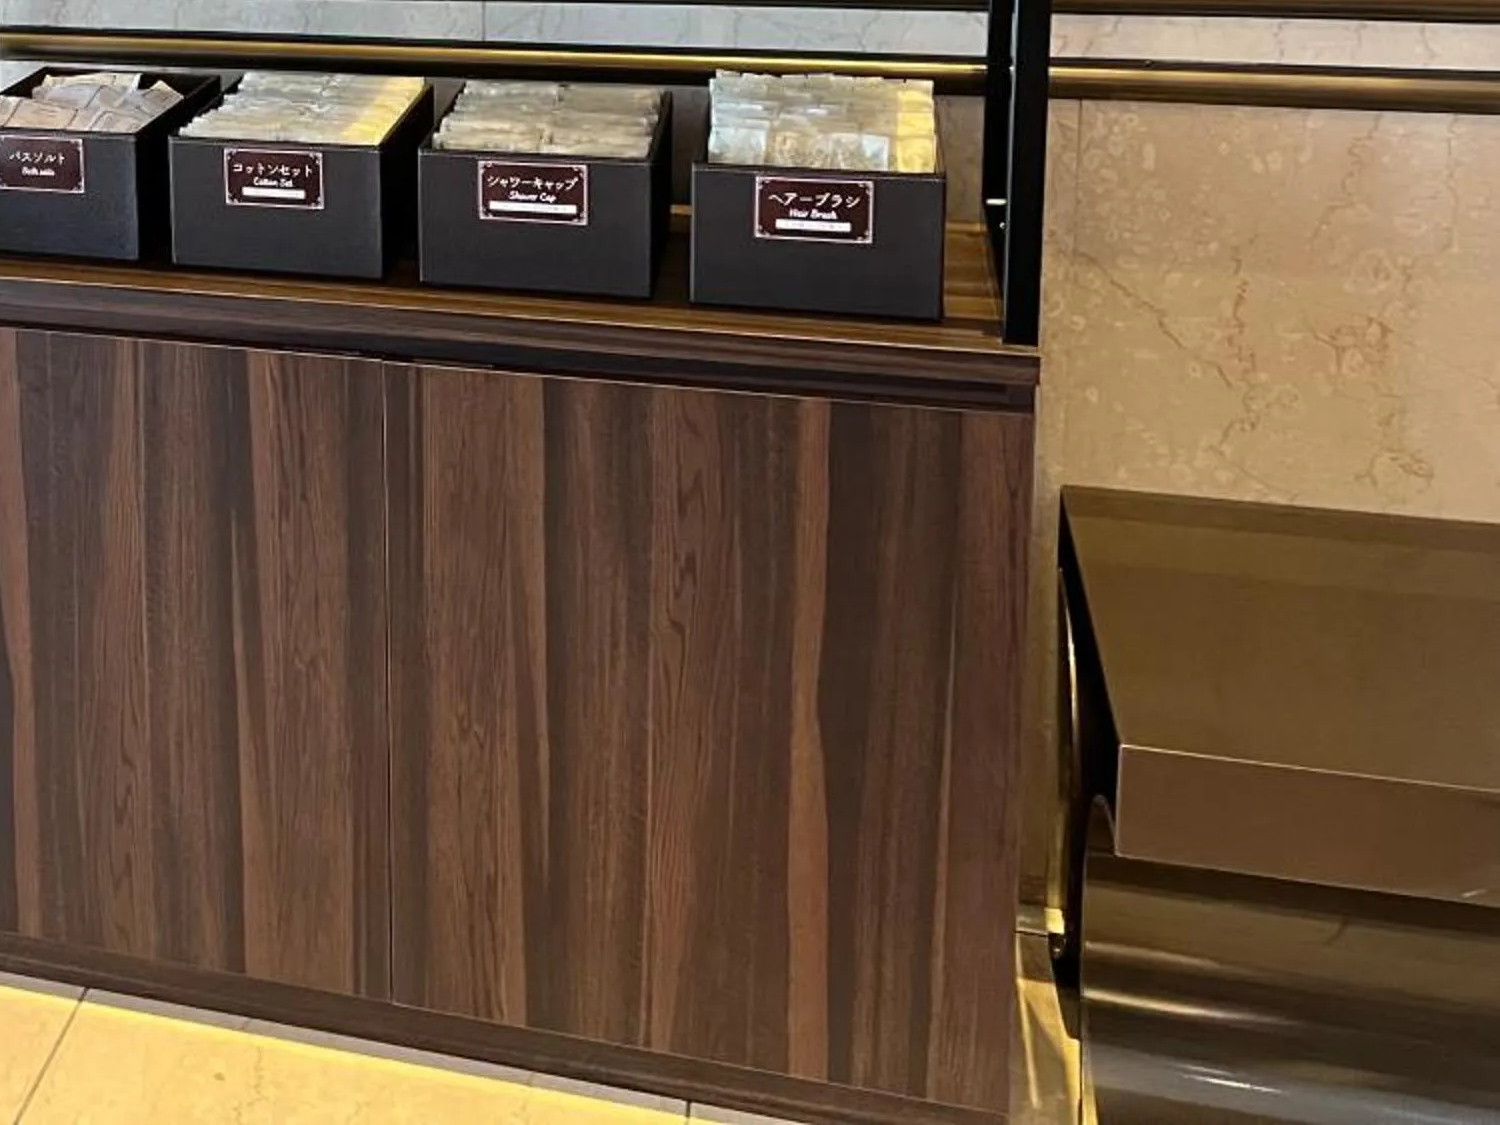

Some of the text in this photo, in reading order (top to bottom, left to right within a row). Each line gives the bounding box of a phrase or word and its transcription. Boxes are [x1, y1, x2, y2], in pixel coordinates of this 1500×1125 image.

[232, 162, 313, 178] コットンセット
[252, 176, 294, 188] Cotton Set
[486, 175, 579, 191] シャワーキャップ
[508, 190, 557, 204] Shower Cap
[767, 191, 861, 208] ヘアーブラシ
[789, 207, 839, 220] Hair Brush
